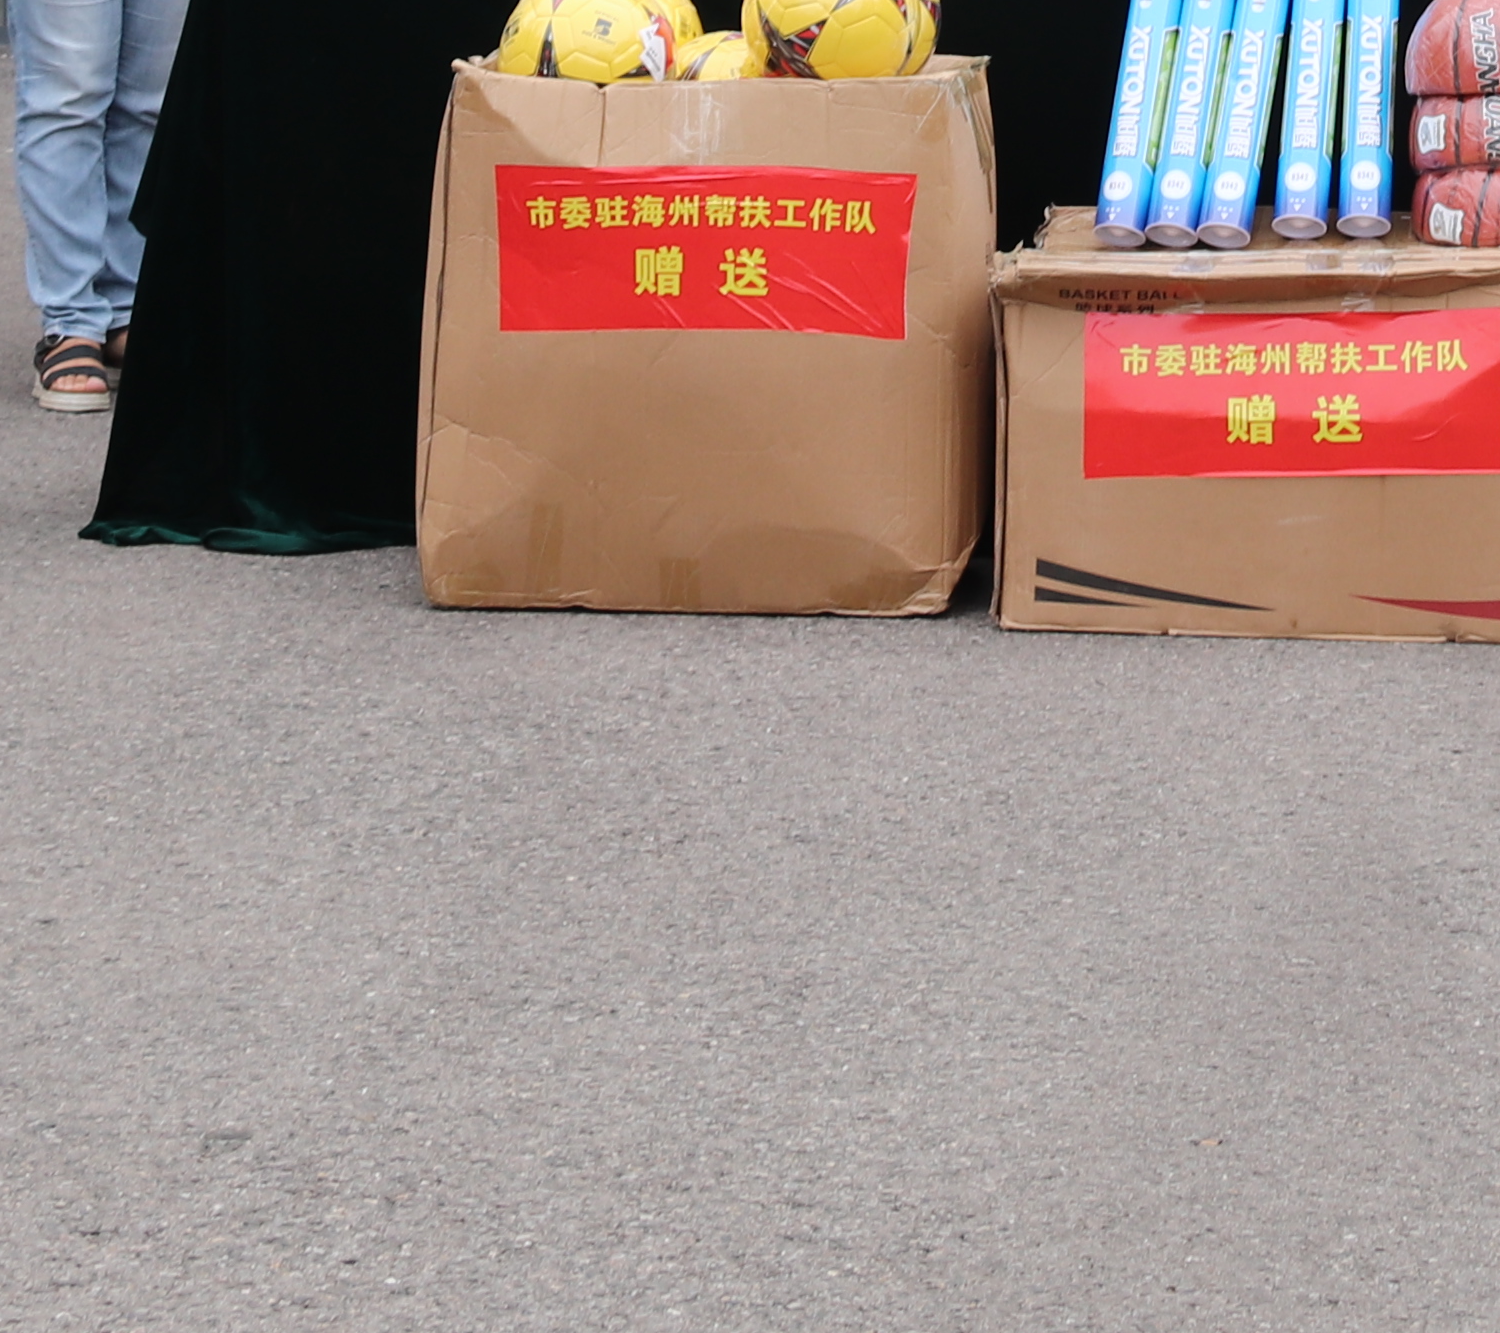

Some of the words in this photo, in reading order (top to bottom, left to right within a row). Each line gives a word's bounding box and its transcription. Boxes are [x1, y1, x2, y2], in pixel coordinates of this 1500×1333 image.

[527, 195, 877, 236] 市委驻海州帮扶工作队
[1059, 289, 1132, 301] BASKET
[1121, 340, 1470, 379] 市委驻海州帮扶工作队
